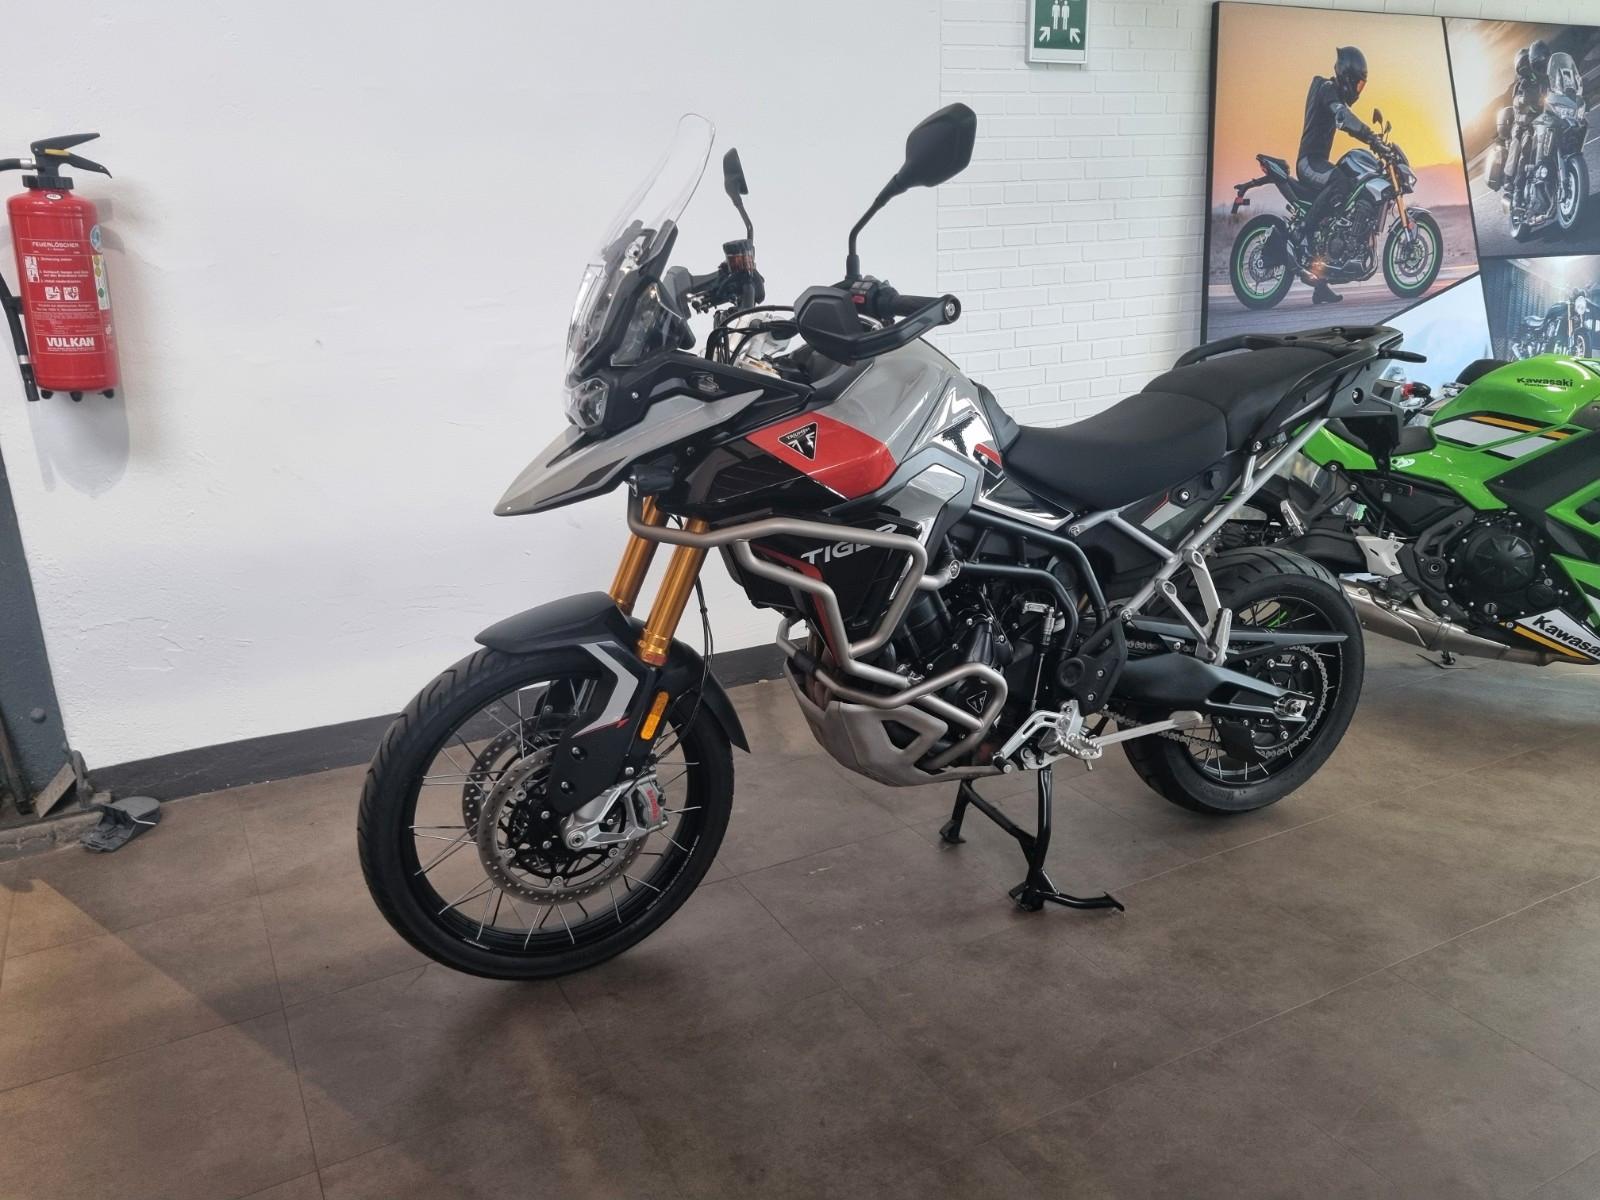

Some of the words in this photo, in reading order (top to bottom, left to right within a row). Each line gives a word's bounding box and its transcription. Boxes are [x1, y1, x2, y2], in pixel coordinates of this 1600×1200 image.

[46, 336, 95, 347] VULKAN
[1516, 377, 1574, 387] Kawasaki
[1532, 615, 1600, 657] Kawasa
